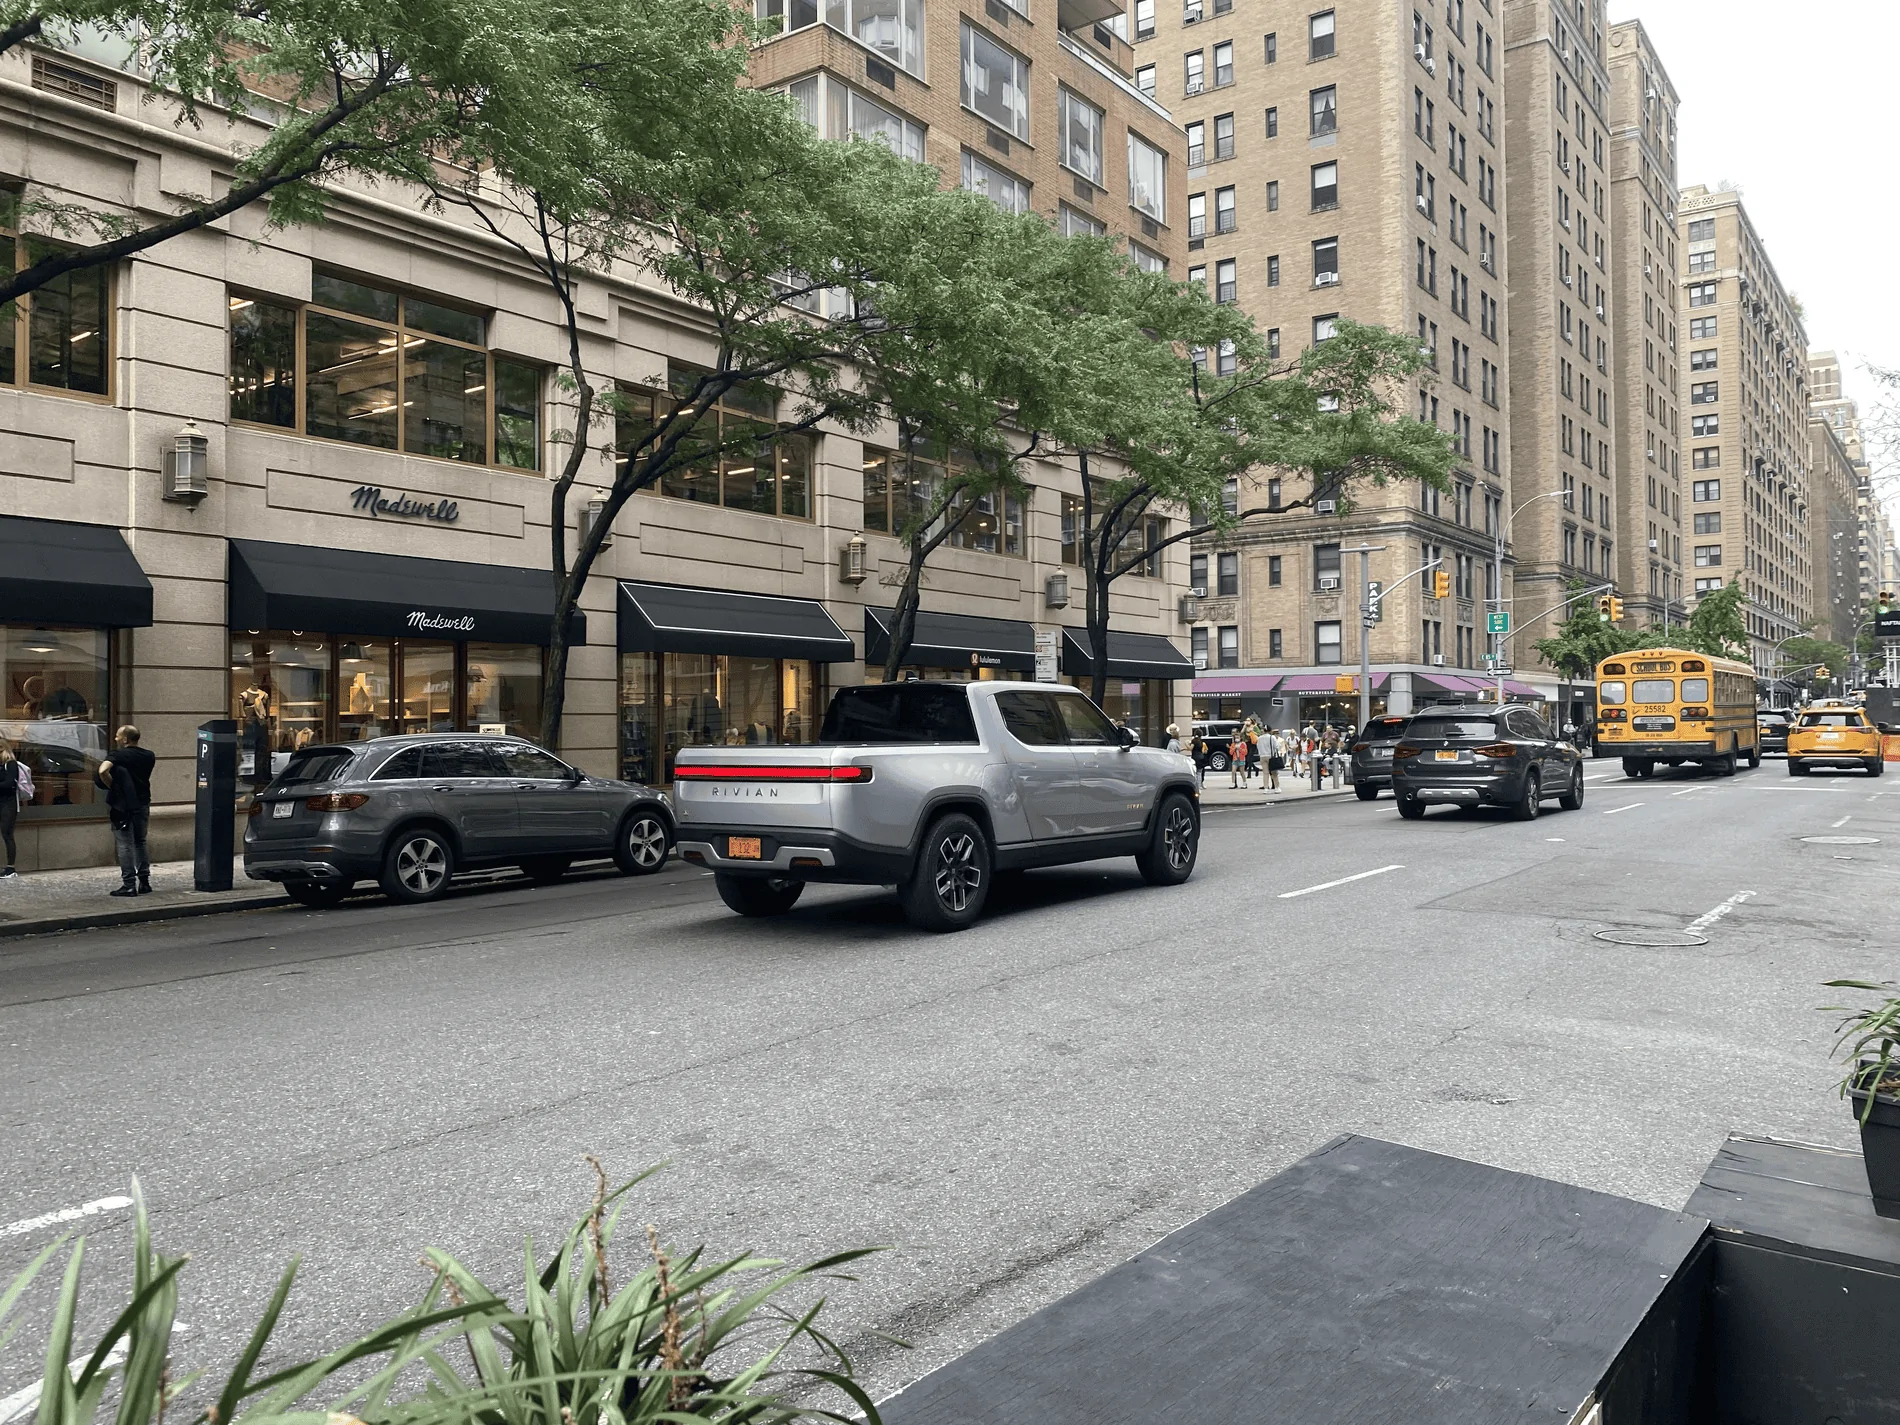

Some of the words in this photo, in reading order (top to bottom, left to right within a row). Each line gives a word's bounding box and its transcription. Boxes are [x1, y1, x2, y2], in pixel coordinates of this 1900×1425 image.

[351, 486, 459, 521] Madewell
[406, 611, 475, 631] Madewell
[980, 656, 1001, 664] lululemon
[1636, 663, 1657, 673] SCHOOL
[1659, 662, 1671, 672] BUS
[1644, 705, 1666, 713] 25582
[712, 787, 778, 797] RIVIAN
